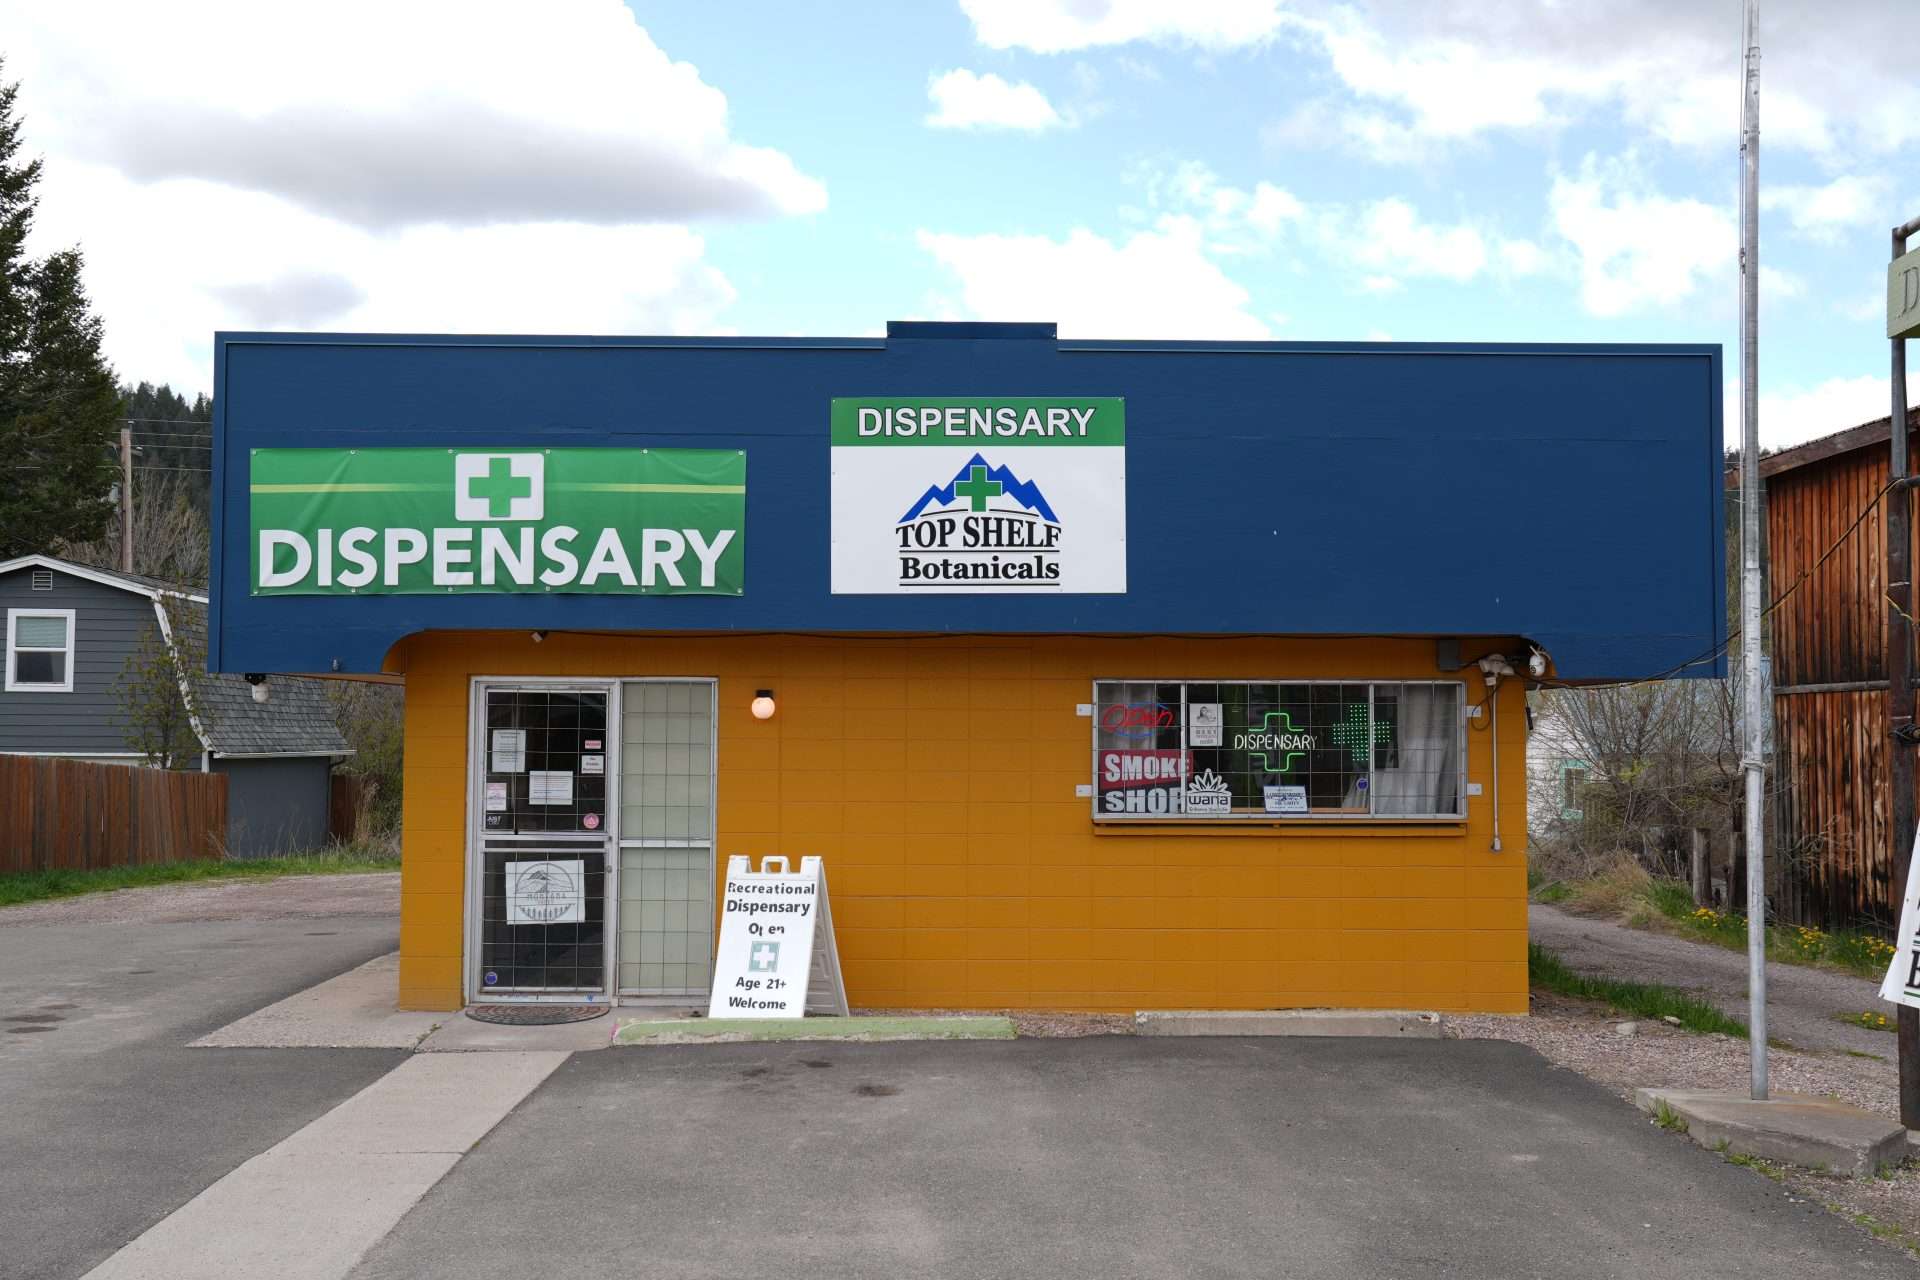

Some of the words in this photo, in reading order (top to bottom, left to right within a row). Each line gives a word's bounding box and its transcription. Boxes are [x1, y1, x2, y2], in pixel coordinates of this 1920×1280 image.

[857, 407, 1096, 437] DISPENSARY
[896, 517, 956, 547] TOP
[963, 516, 1062, 547] SHELF
[259, 525, 735, 588] DISPENSARY
[899, 555, 1060, 579] Botanicals
[1234, 735, 1317, 749] DISPENSARY
[1105, 754, 1189, 782] SMOKE
[1189, 796, 1228, 805] wana
[728, 882, 815, 895] Recreational
[727, 899, 810, 916] Dispensary
[736, 976, 760, 990] Age
[766, 978, 787, 989] 21+
[729, 996, 786, 1009] Welcome
